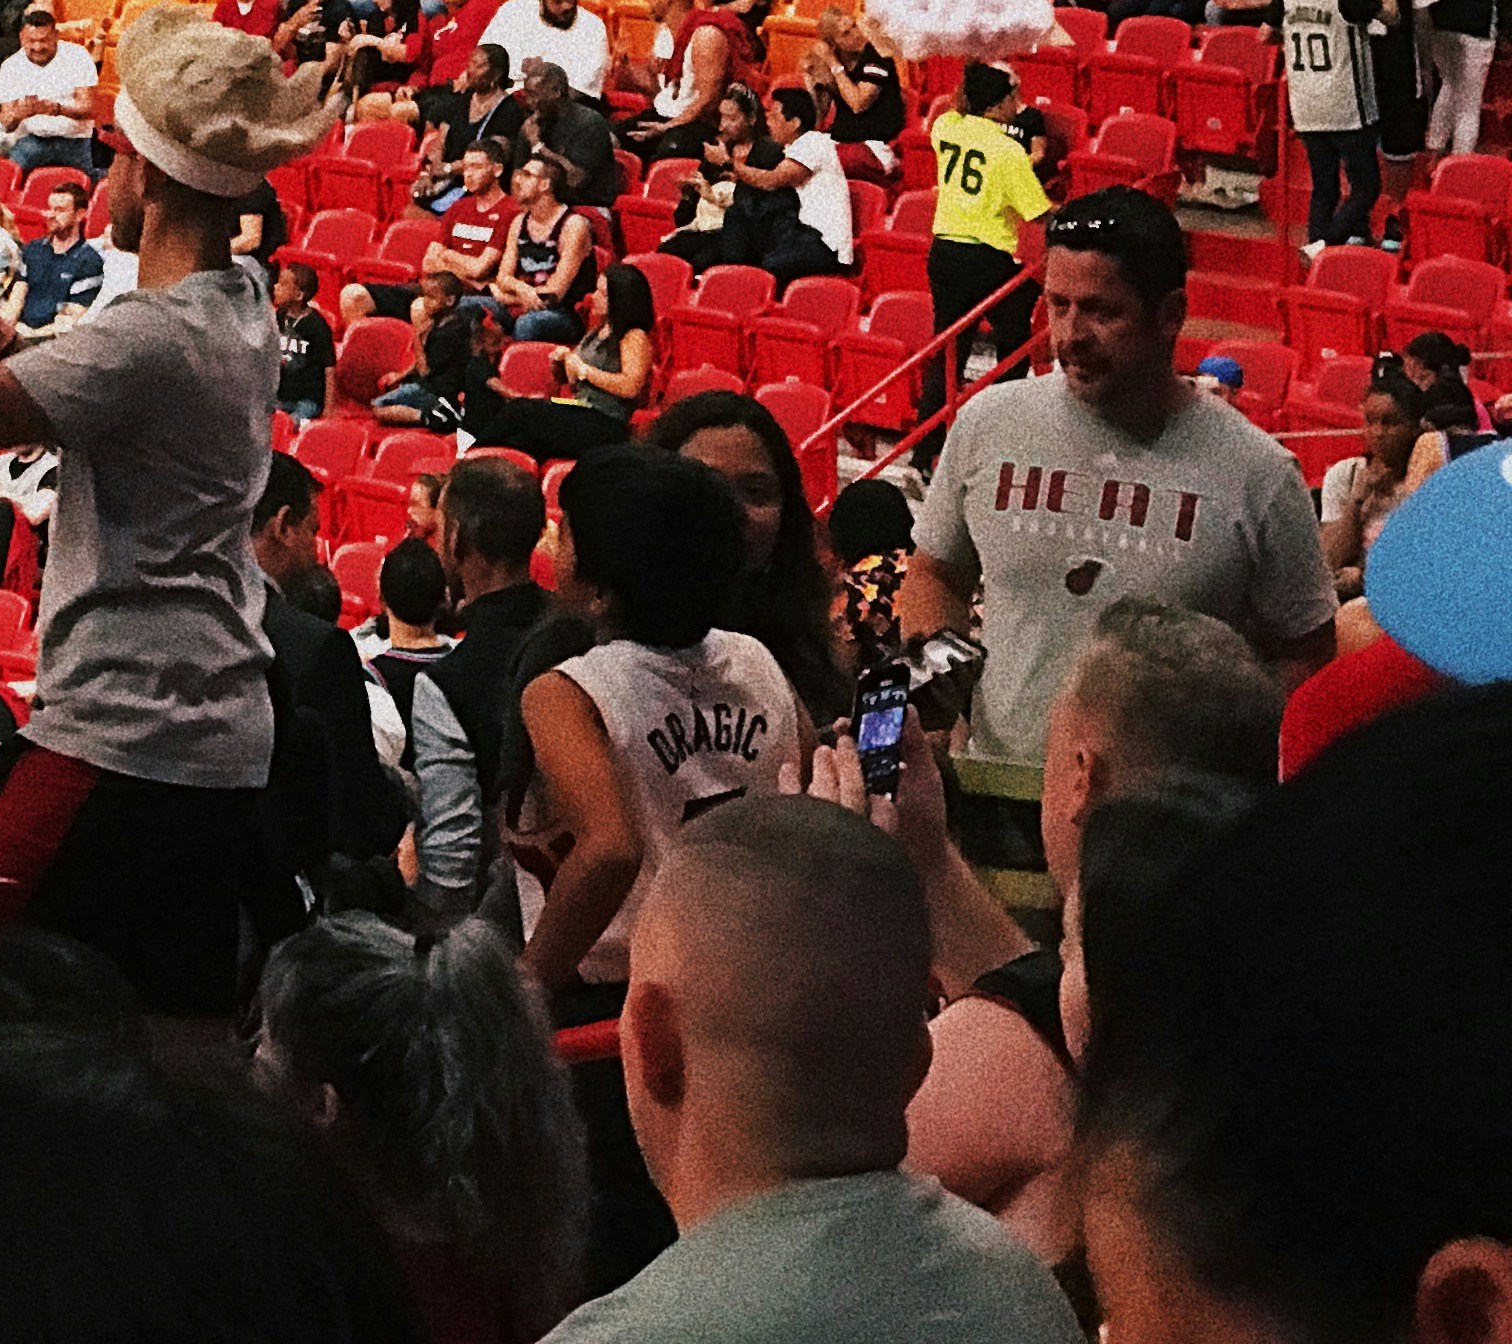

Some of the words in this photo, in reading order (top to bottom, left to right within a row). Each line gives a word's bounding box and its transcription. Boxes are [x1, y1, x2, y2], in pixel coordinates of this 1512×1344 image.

[1290, 32, 1332, 72] 10
[939, 139, 987, 196] 76
[994, 461, 1202, 543] HEAT
